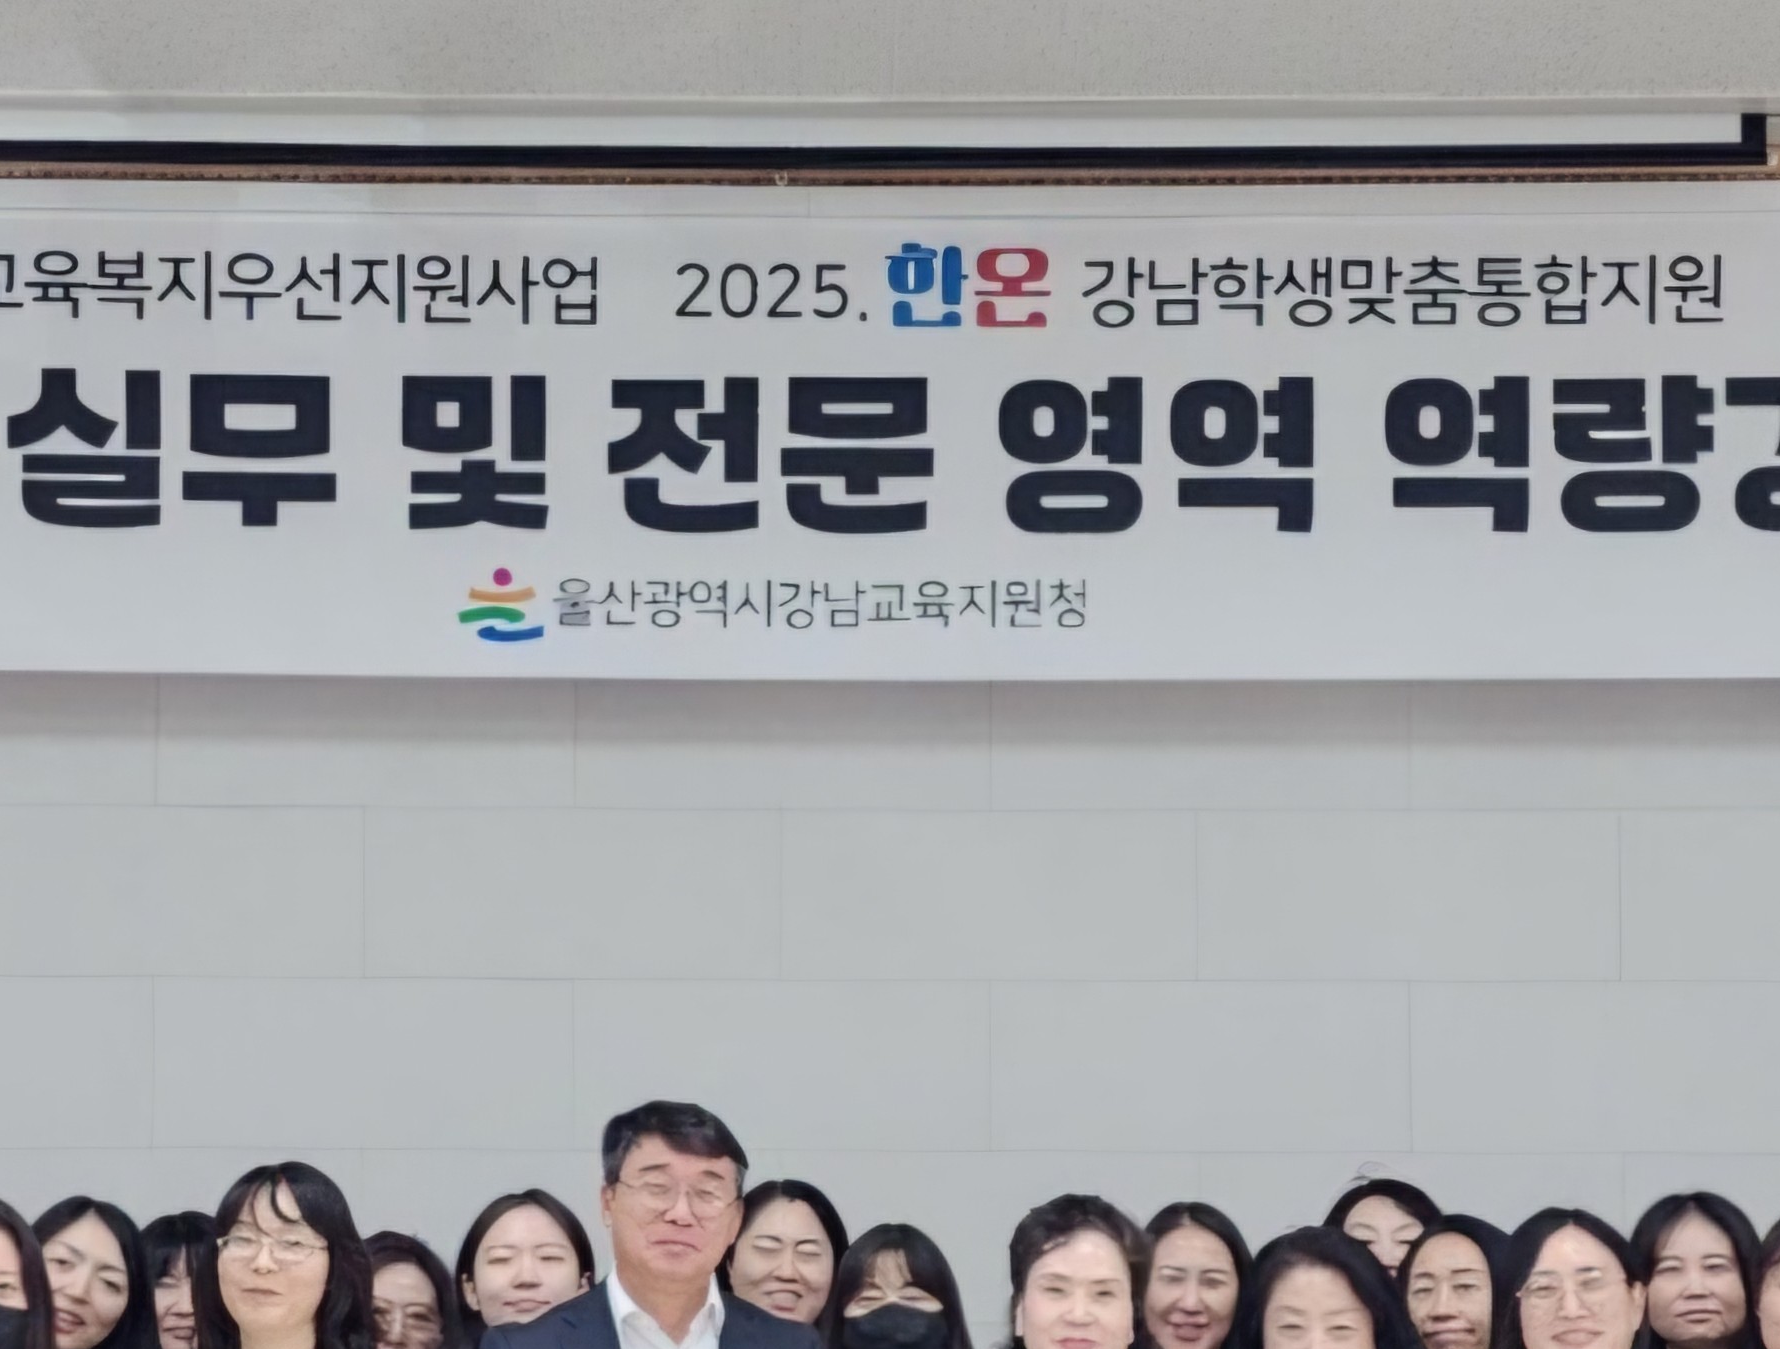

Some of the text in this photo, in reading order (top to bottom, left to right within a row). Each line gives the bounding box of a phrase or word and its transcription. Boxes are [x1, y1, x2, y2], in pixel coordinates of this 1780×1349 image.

[1081, 254, 1725, 328] 강남학생맞춤통합지원
[6, 367, 337, 529] 실무
[401, 374, 549, 531] 및
[607, 376, 935, 535] 전문
[998, 376, 1315, 534] 영역
[553, 576, 1088, 630] 울산광역시강남교육지원청
